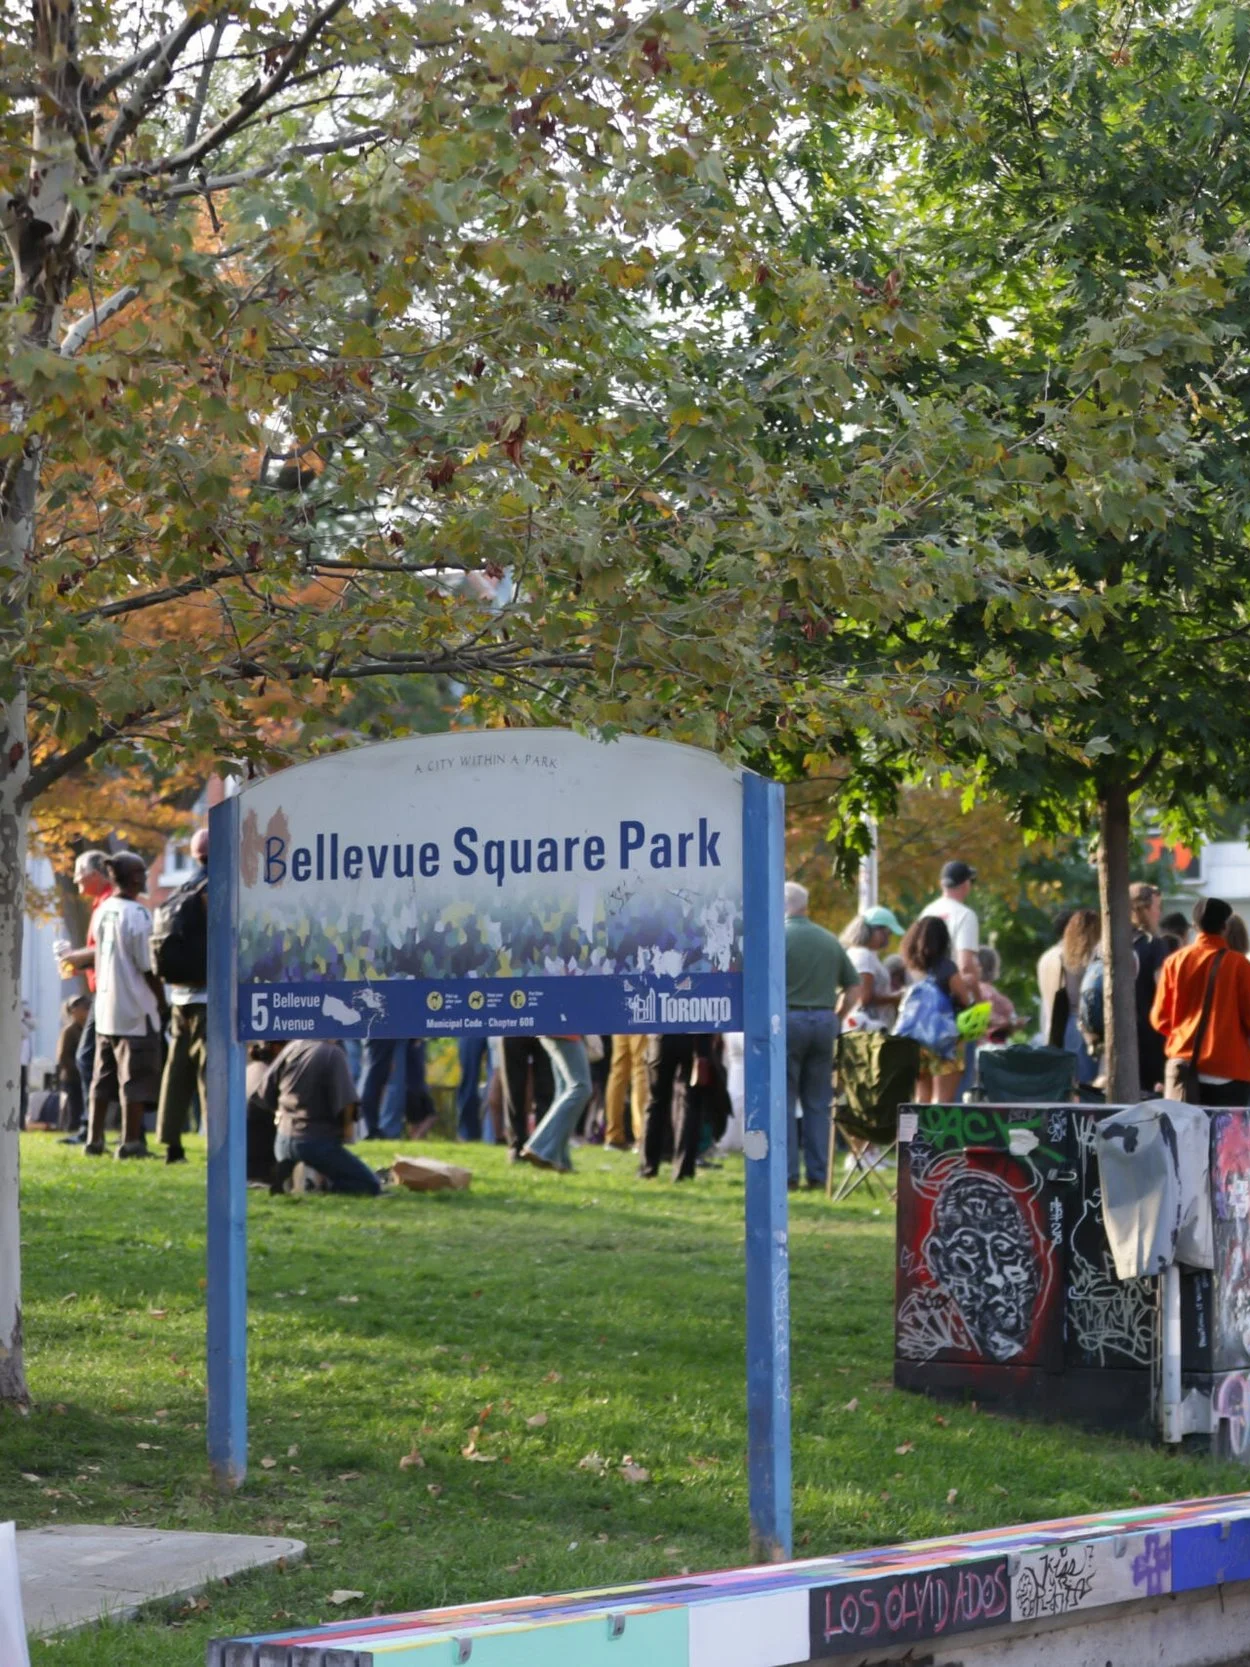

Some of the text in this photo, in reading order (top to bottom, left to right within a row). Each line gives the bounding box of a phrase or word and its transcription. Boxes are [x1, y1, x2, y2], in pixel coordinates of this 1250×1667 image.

[414, 754, 558, 775] A CITY WITHIN A PARK
[263, 817, 721, 887] Bellevue Square Park
[272, 992, 321, 1008] Bellevue
[658, 992, 732, 1023] TORONTO
[251, 992, 269, 1032] 5
[272, 1015, 315, 1031] Avenue
[426, 1018, 463, 1031] Municipal
[464, 1018, 482, 1028] Code
[488, 1017, 518, 1029] Chapter
